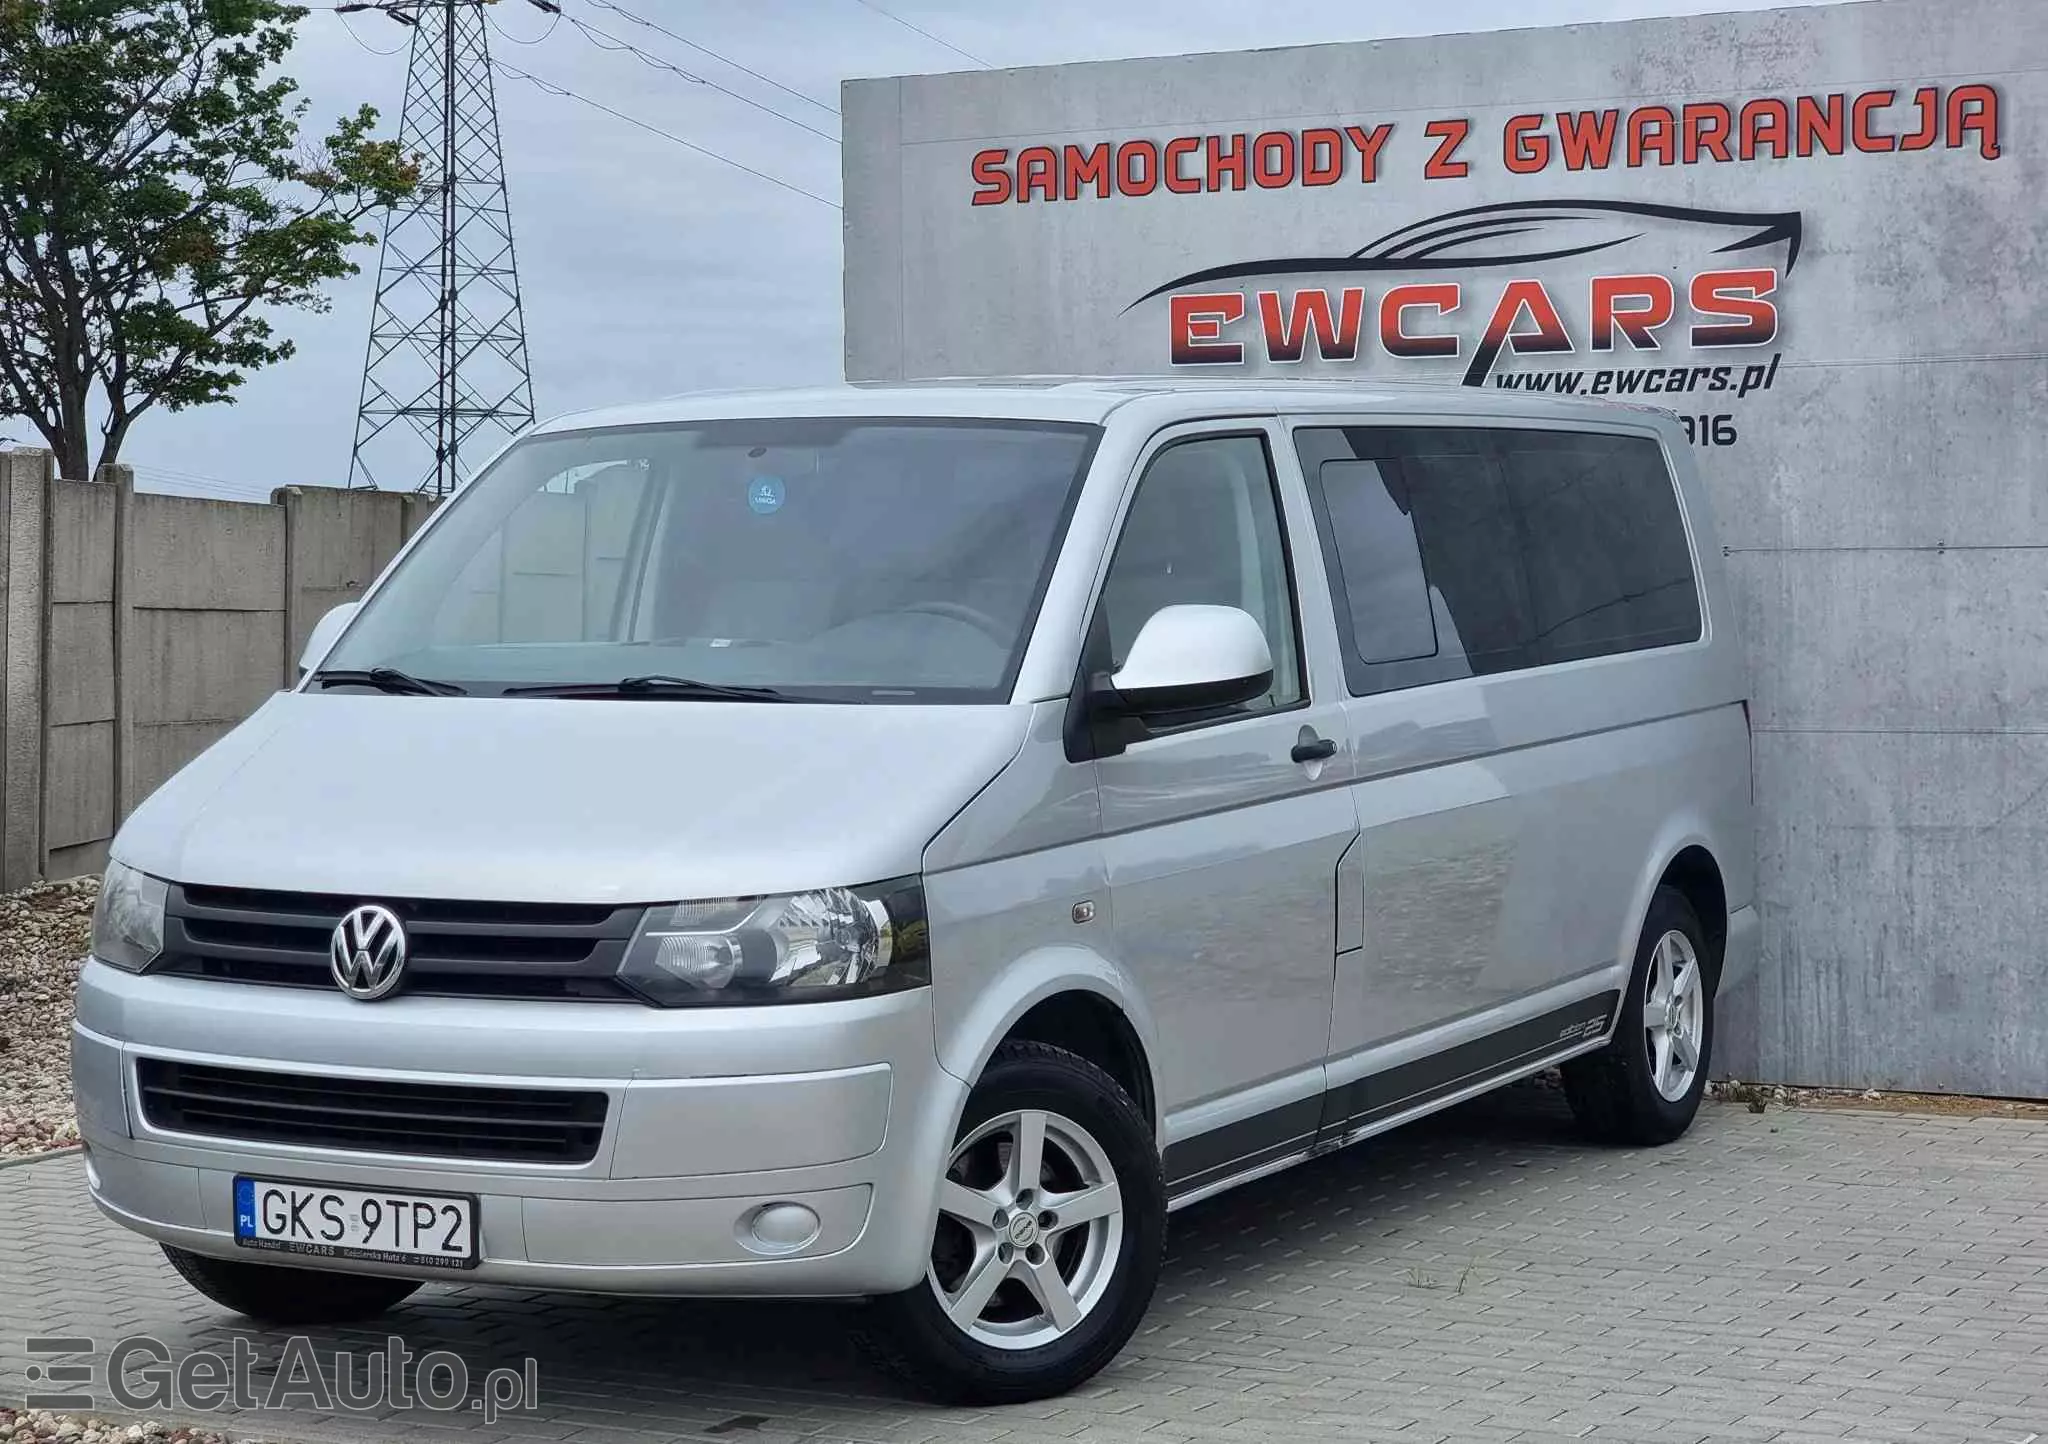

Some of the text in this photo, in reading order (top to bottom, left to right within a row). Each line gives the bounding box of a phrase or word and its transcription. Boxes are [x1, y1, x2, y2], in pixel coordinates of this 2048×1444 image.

[971, 83, 2002, 206] SAMOCHODY Z GWARANCJĄ
[1168, 267, 1780, 387] EWCARS
[1496, 353, 1782, 398] www.ewcars.pl
[239, 1214, 254, 1228] PL
[262, 1188, 464, 1253] GKS 9TP2
[288, 1242, 335, 1257] EWCARS
